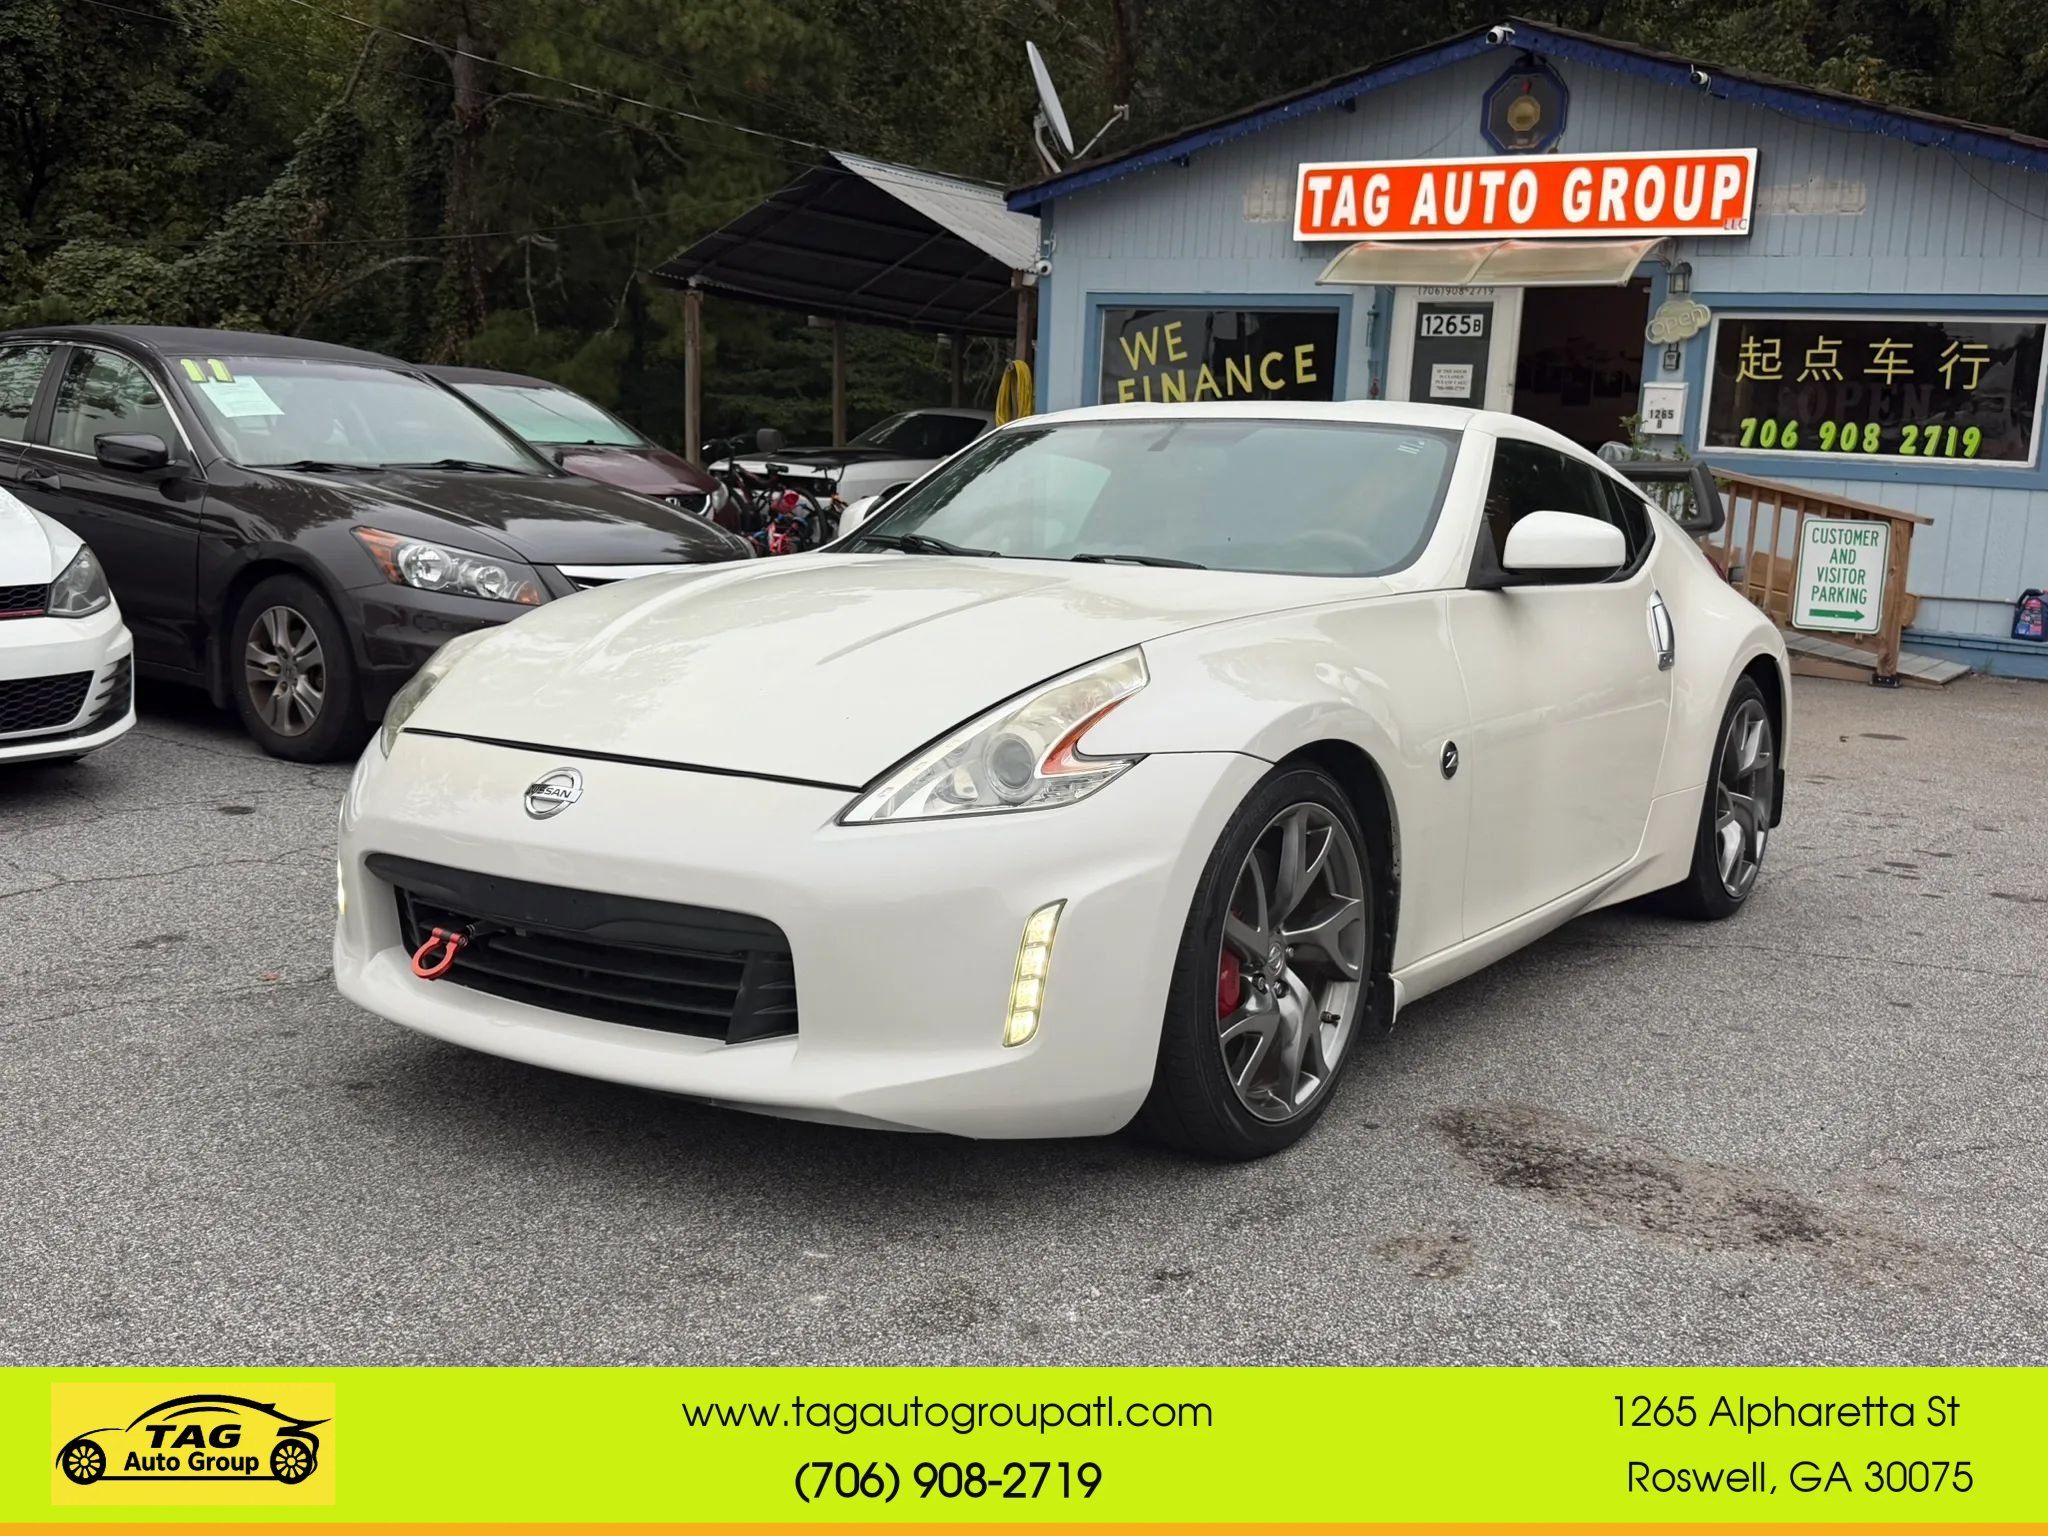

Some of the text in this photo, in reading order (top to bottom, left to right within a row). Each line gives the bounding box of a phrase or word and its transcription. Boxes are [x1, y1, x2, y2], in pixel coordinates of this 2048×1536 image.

[1308, 163, 1743, 228] TAG AUTO GROUP
[1119, 320, 1188, 371] WE
[180, 357, 236, 384] 11
[1117, 343, 1318, 404] FINANCE
[1736, 335, 1991, 391] 起点车行
[1649, 408, 1675, 420] 1265
[1739, 417, 1983, 458] 706 908 2719
[1811, 527, 1880, 547] CUSTOMER
[1829, 548, 1857, 565] AND
[1816, 566, 1867, 586] VISITOR
[1810, 585, 1868, 605] PARKING
